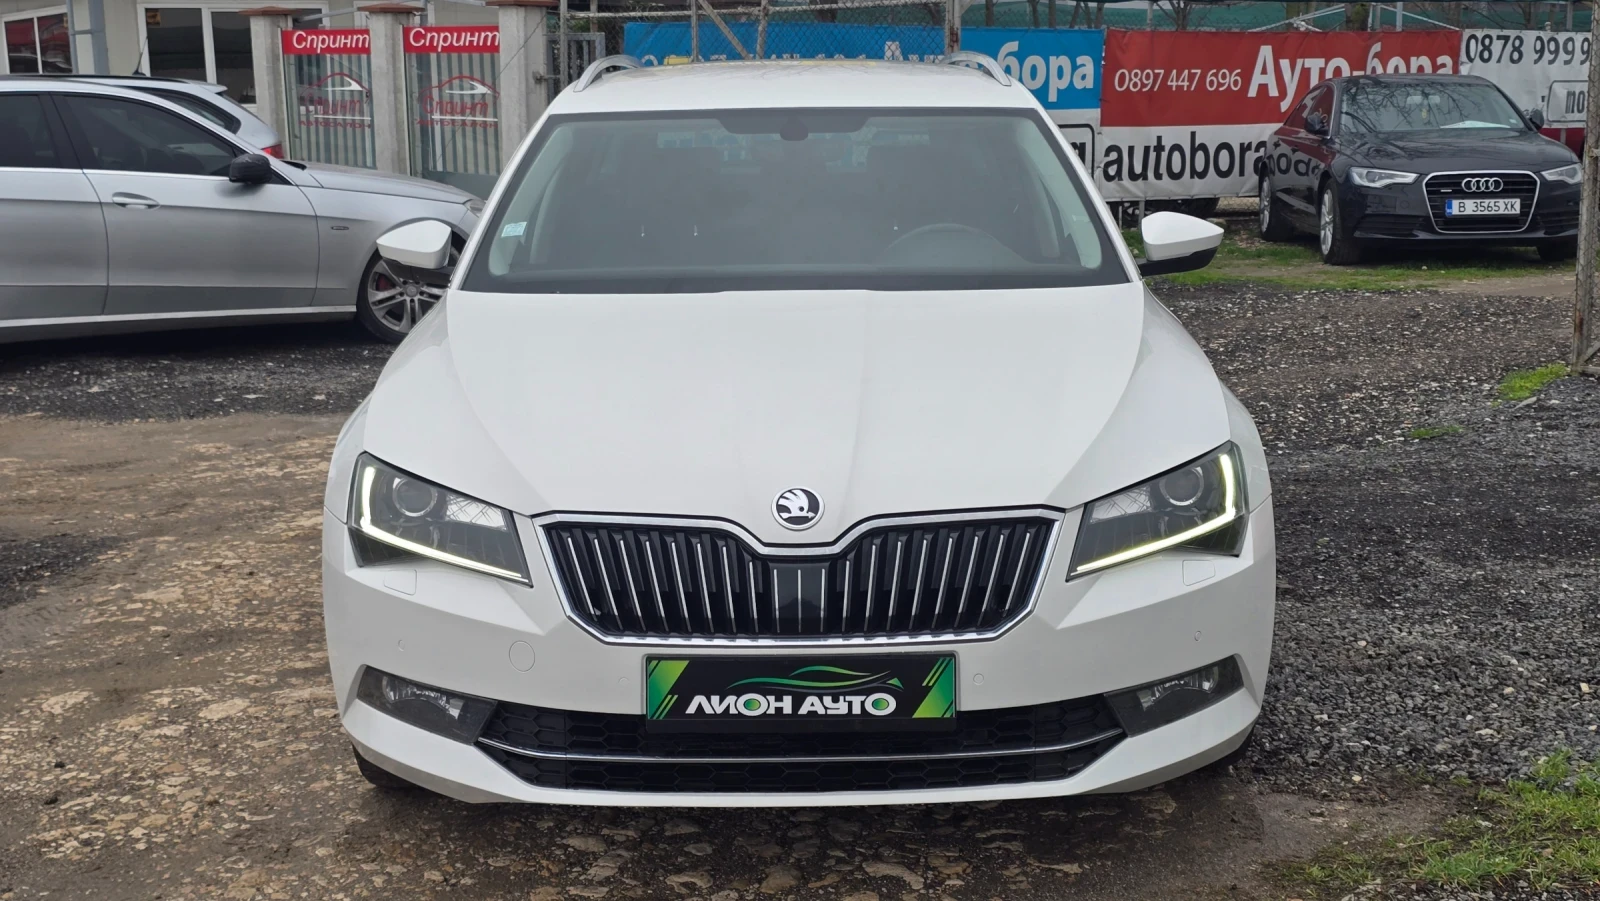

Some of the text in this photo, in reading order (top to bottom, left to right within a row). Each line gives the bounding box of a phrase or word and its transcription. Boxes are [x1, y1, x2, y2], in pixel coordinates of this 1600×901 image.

[292, 31, 370, 54] Спринт
[409, 27, 499, 52] Спринт
[1465, 33, 1524, 65] 0878
[1114, 69, 1242, 92] 0897 447 696
[422, 95, 489, 116] Спринт
[1458, 201, 1466, 213] B
[1472, 201, 1500, 213] 3565
[1503, 200, 1518, 213] XK
[685, 692, 897, 717] ЛИОН АУТО
